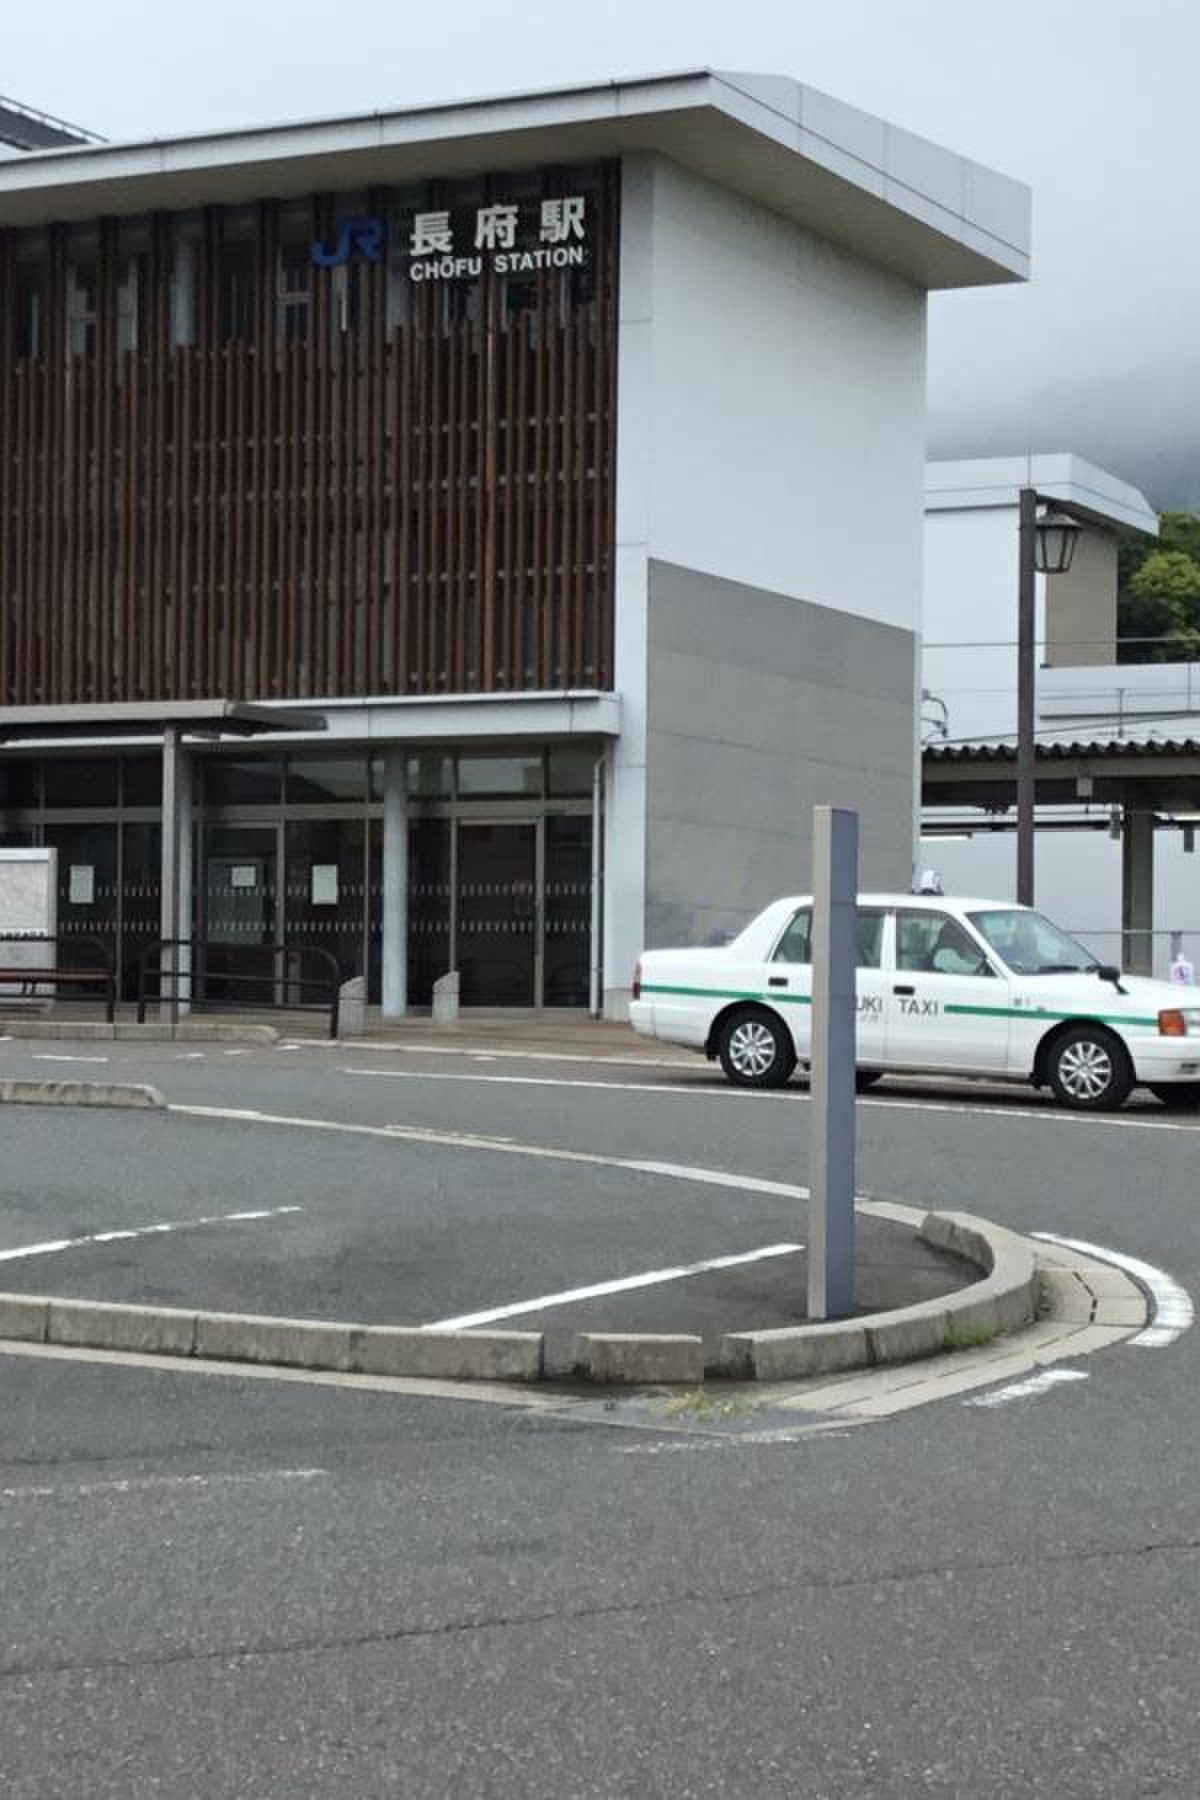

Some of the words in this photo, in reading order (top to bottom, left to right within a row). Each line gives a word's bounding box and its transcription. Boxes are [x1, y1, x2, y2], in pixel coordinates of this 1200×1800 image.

[311, 216, 385, 266] JR
[410, 197, 585, 257] 長府駅
[495, 245, 583, 273] STATION
[898, 999, 938, 1016] TAXI
